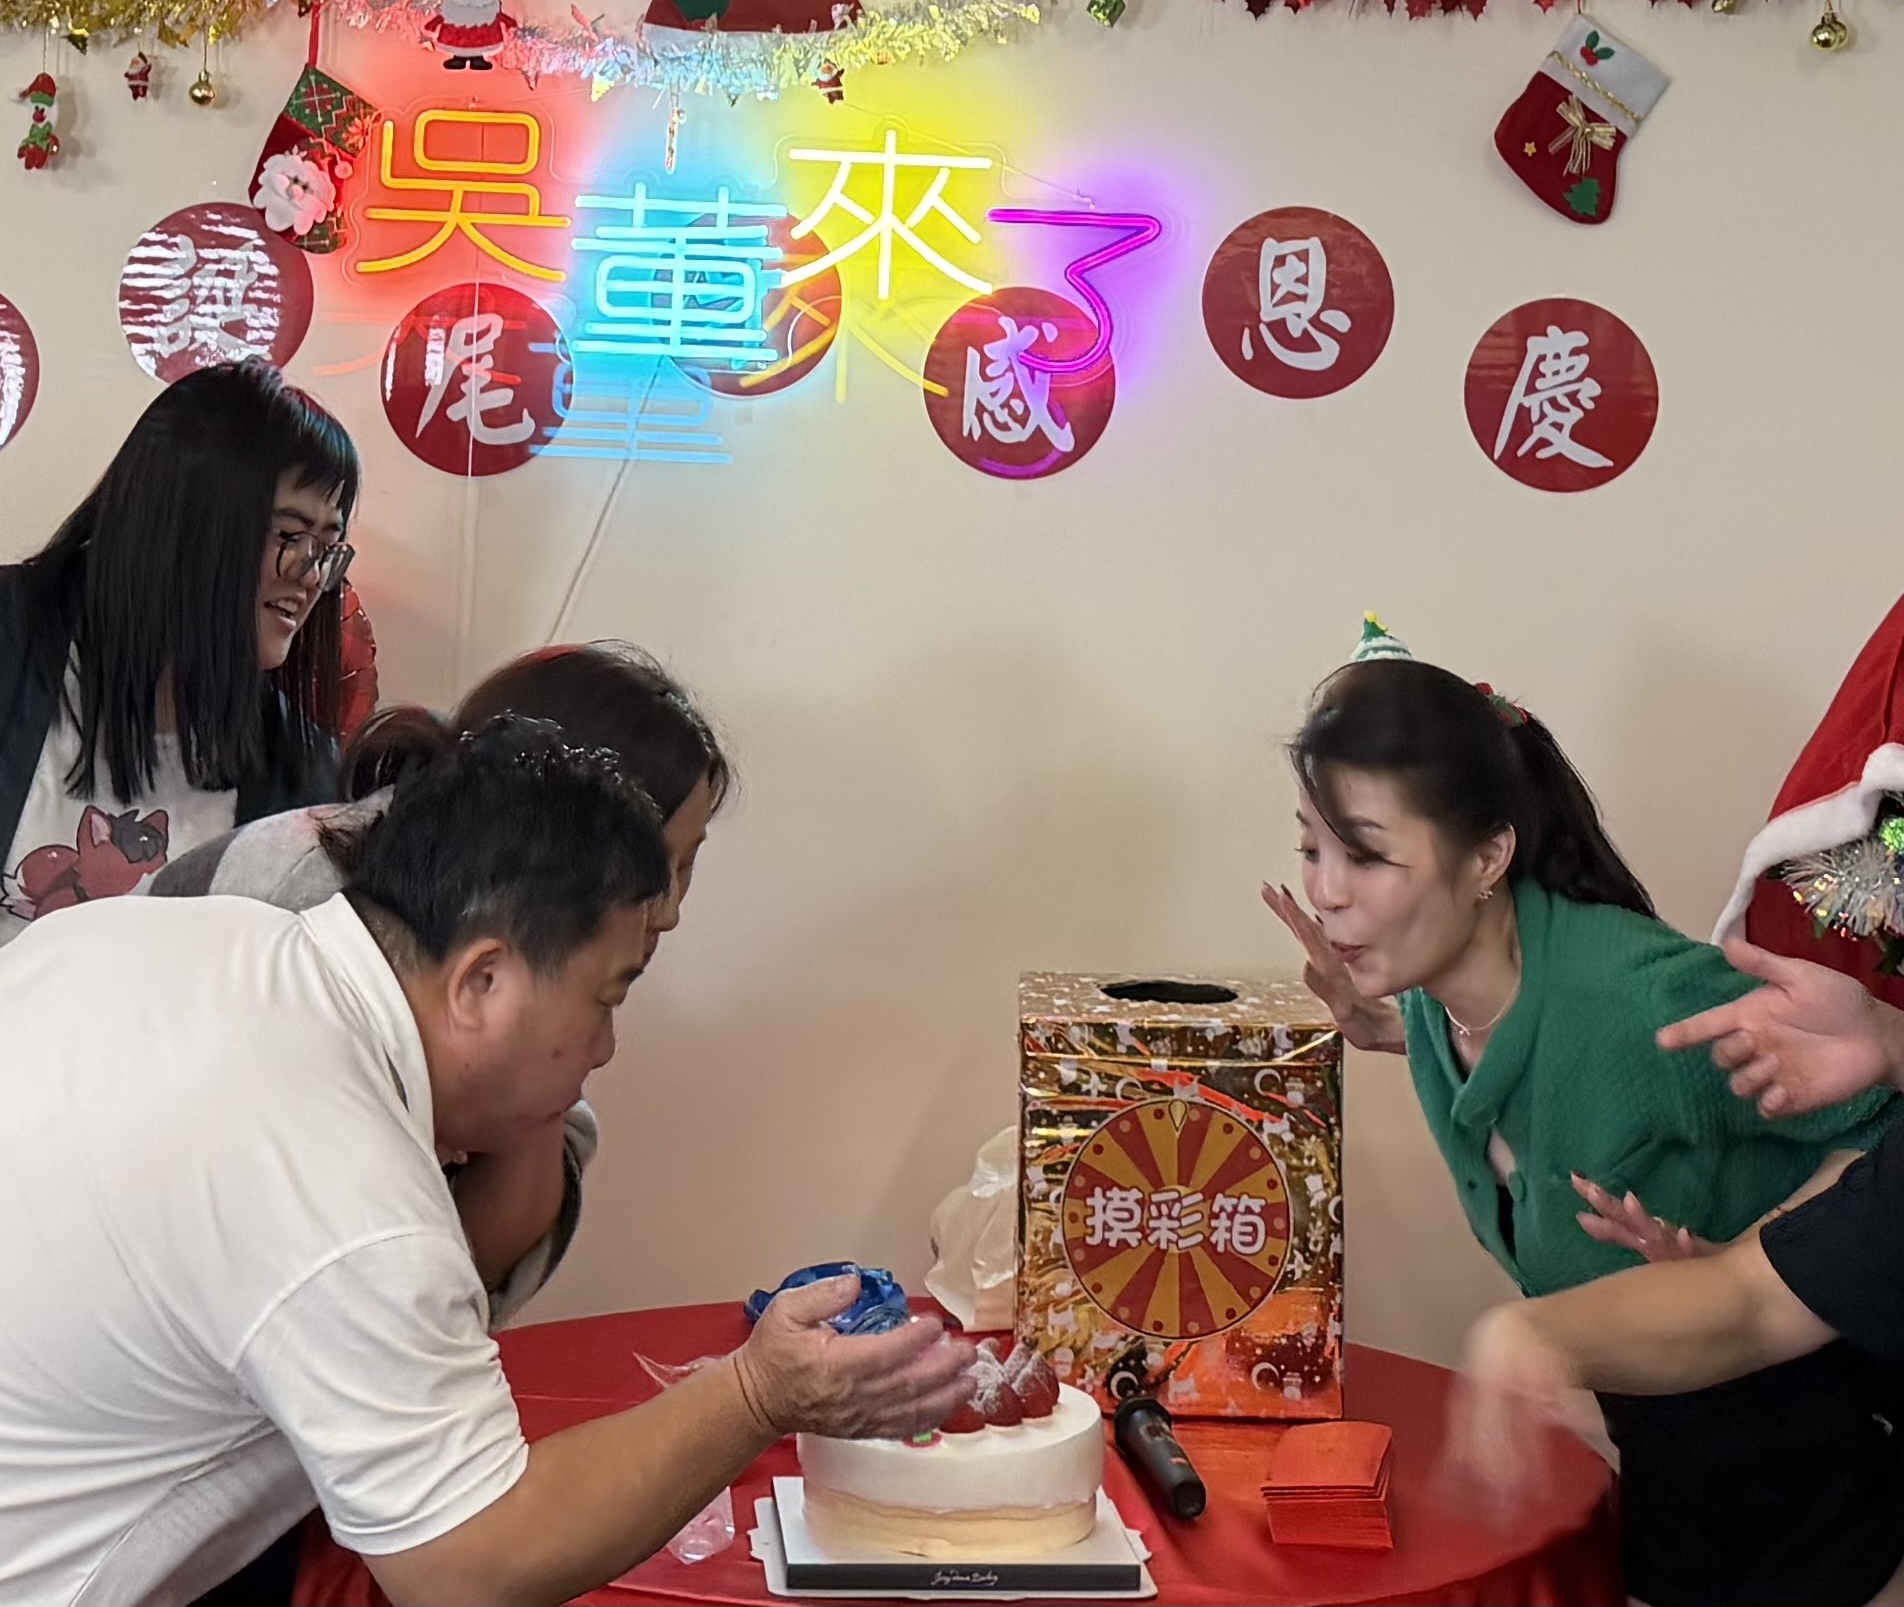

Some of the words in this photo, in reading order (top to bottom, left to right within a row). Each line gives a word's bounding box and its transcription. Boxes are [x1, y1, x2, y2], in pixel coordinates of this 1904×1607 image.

[356, 109, 1161, 372] 吳董來了
[417, 313, 535, 445] 尾
[962, 316, 1075, 452] 感
[1242, 237, 1352, 370] 恩
[1494, 325, 1615, 468] 慶
[1085, 1186, 1267, 1255] 摸彩箱
